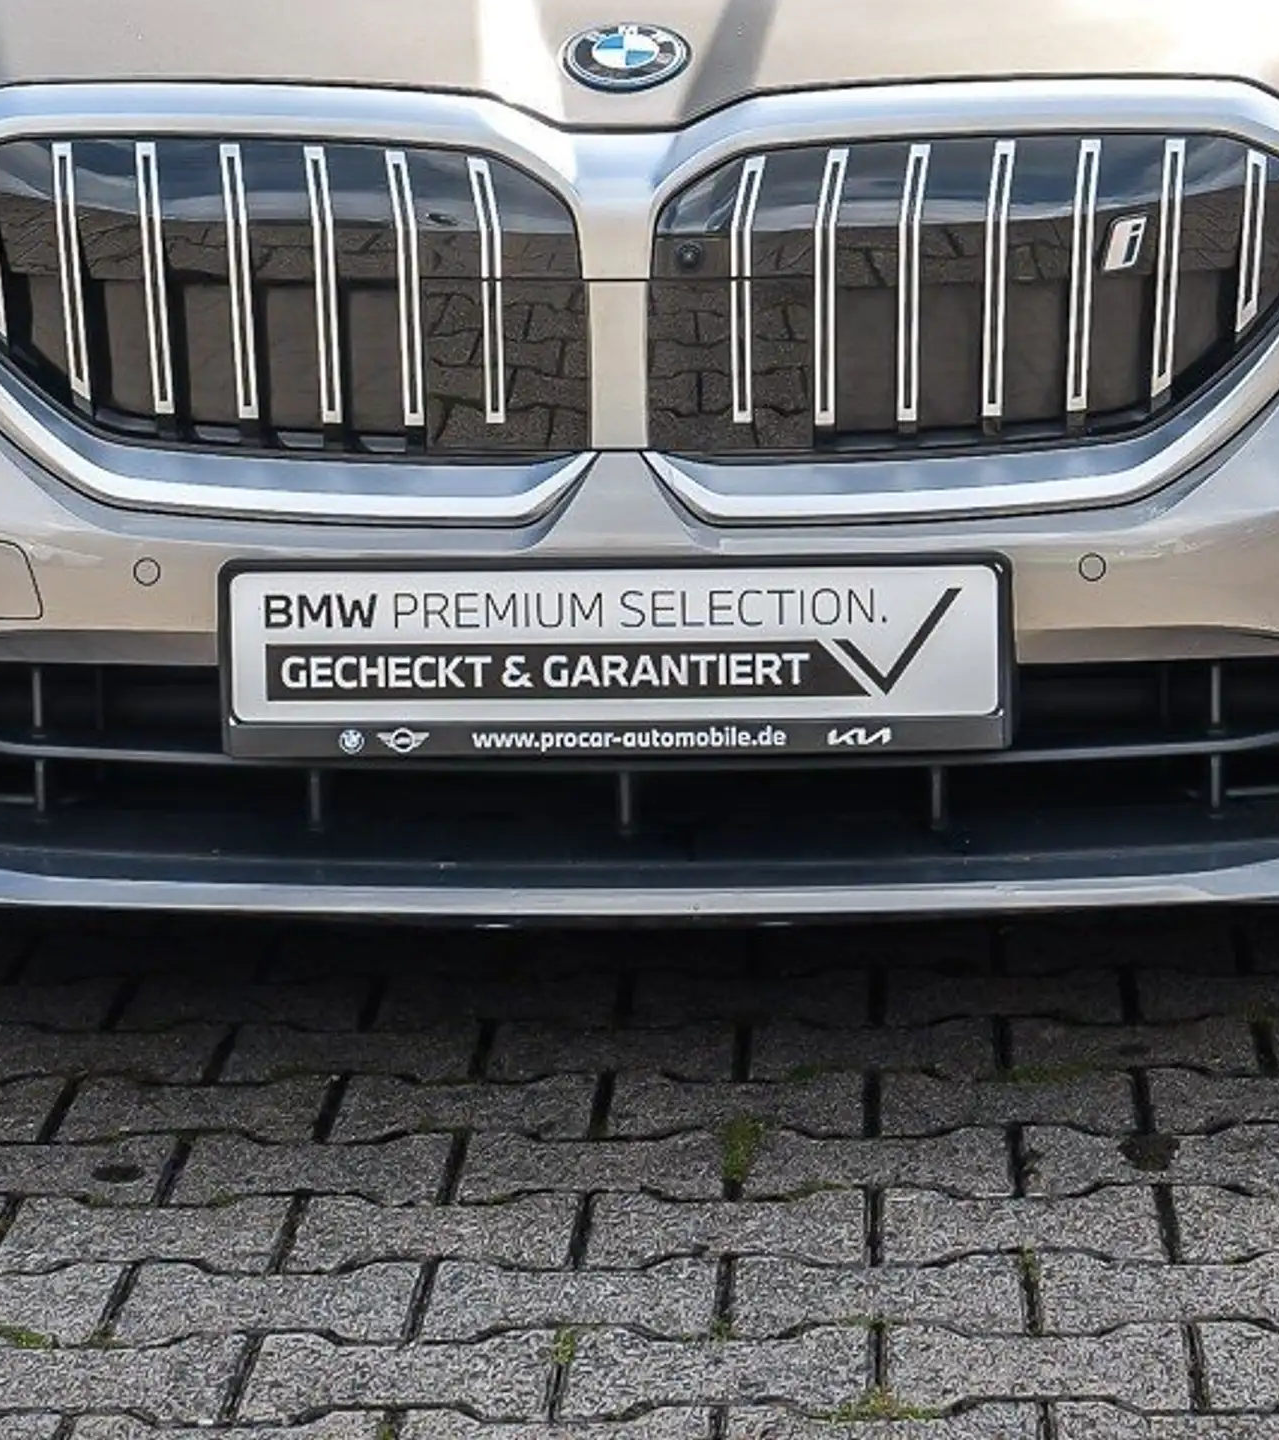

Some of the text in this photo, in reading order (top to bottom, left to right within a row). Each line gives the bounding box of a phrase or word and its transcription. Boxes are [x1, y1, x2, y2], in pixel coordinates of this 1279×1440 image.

[264, 587, 888, 629] BMW PREMIUM SELECTION.
[280, 652, 811, 688] GECHECKT & GARANTIERT
[471, 725, 787, 752] www.procar-automobile.de
